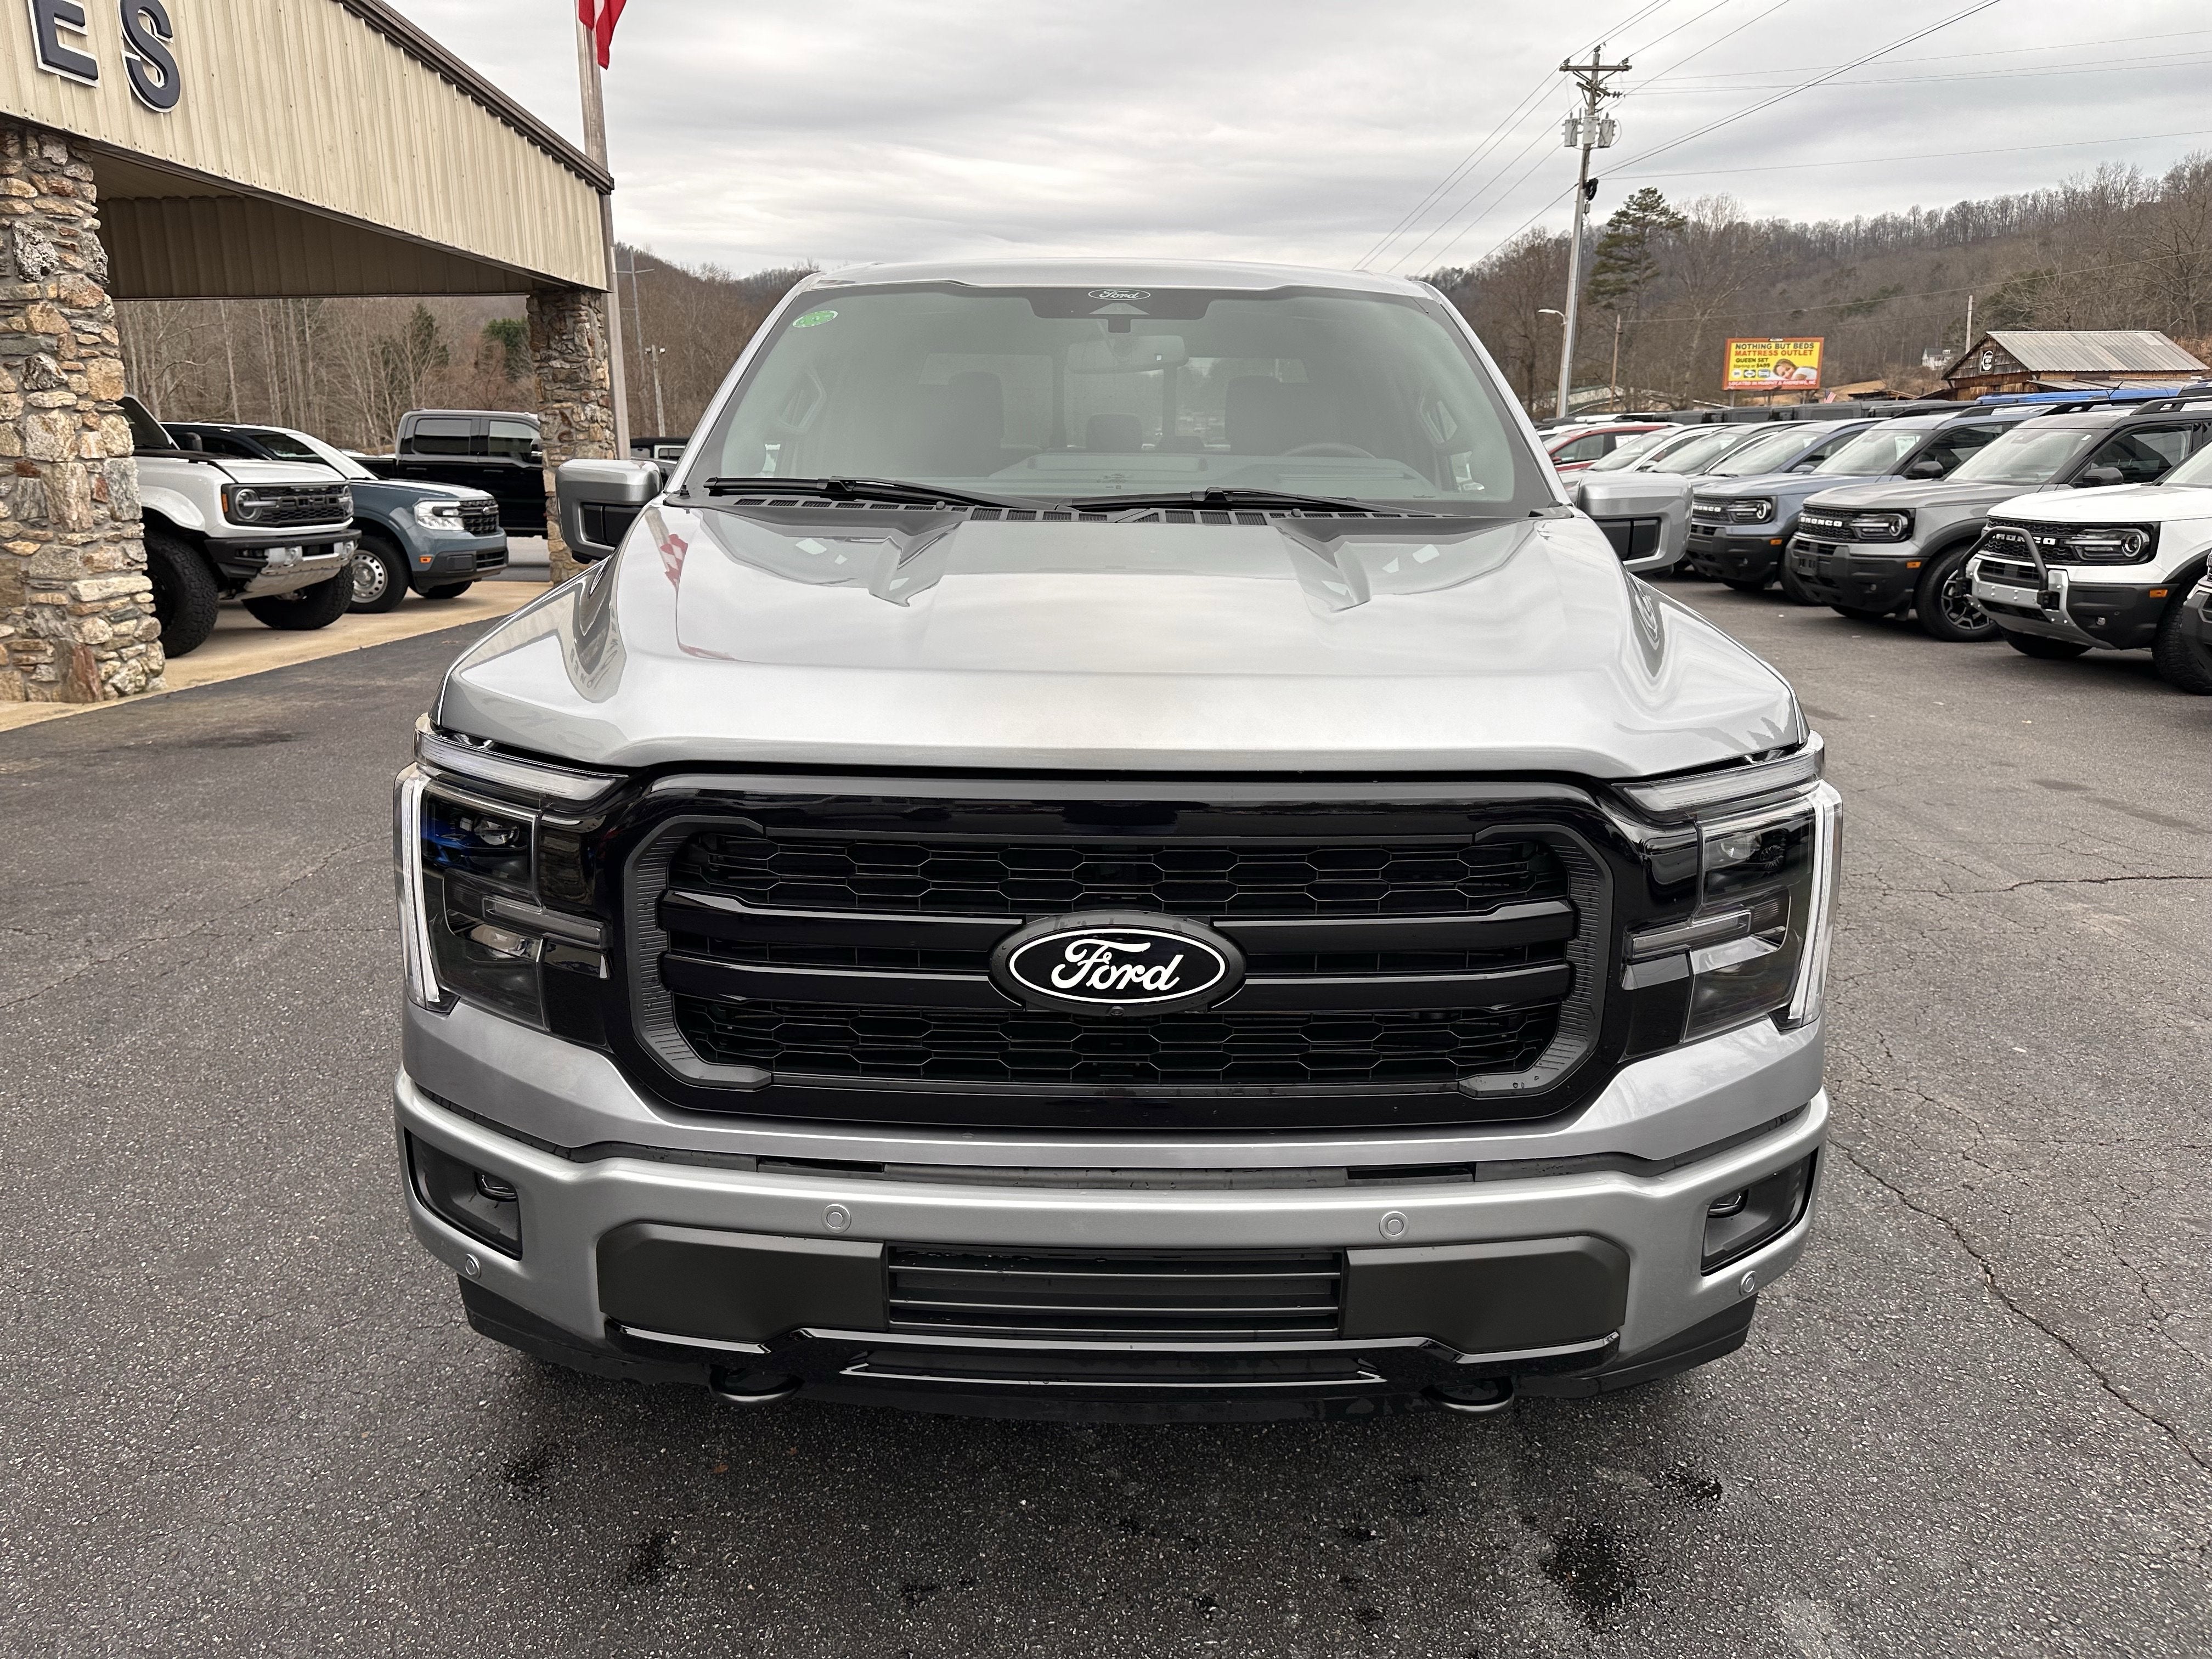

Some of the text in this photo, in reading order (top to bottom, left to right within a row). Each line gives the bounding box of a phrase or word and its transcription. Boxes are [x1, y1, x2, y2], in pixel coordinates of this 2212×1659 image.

[1099, 290, 1139, 298] Ford
[1800, 516, 1843, 527] BRONCO
[1051, 939, 1184, 991] Ford
